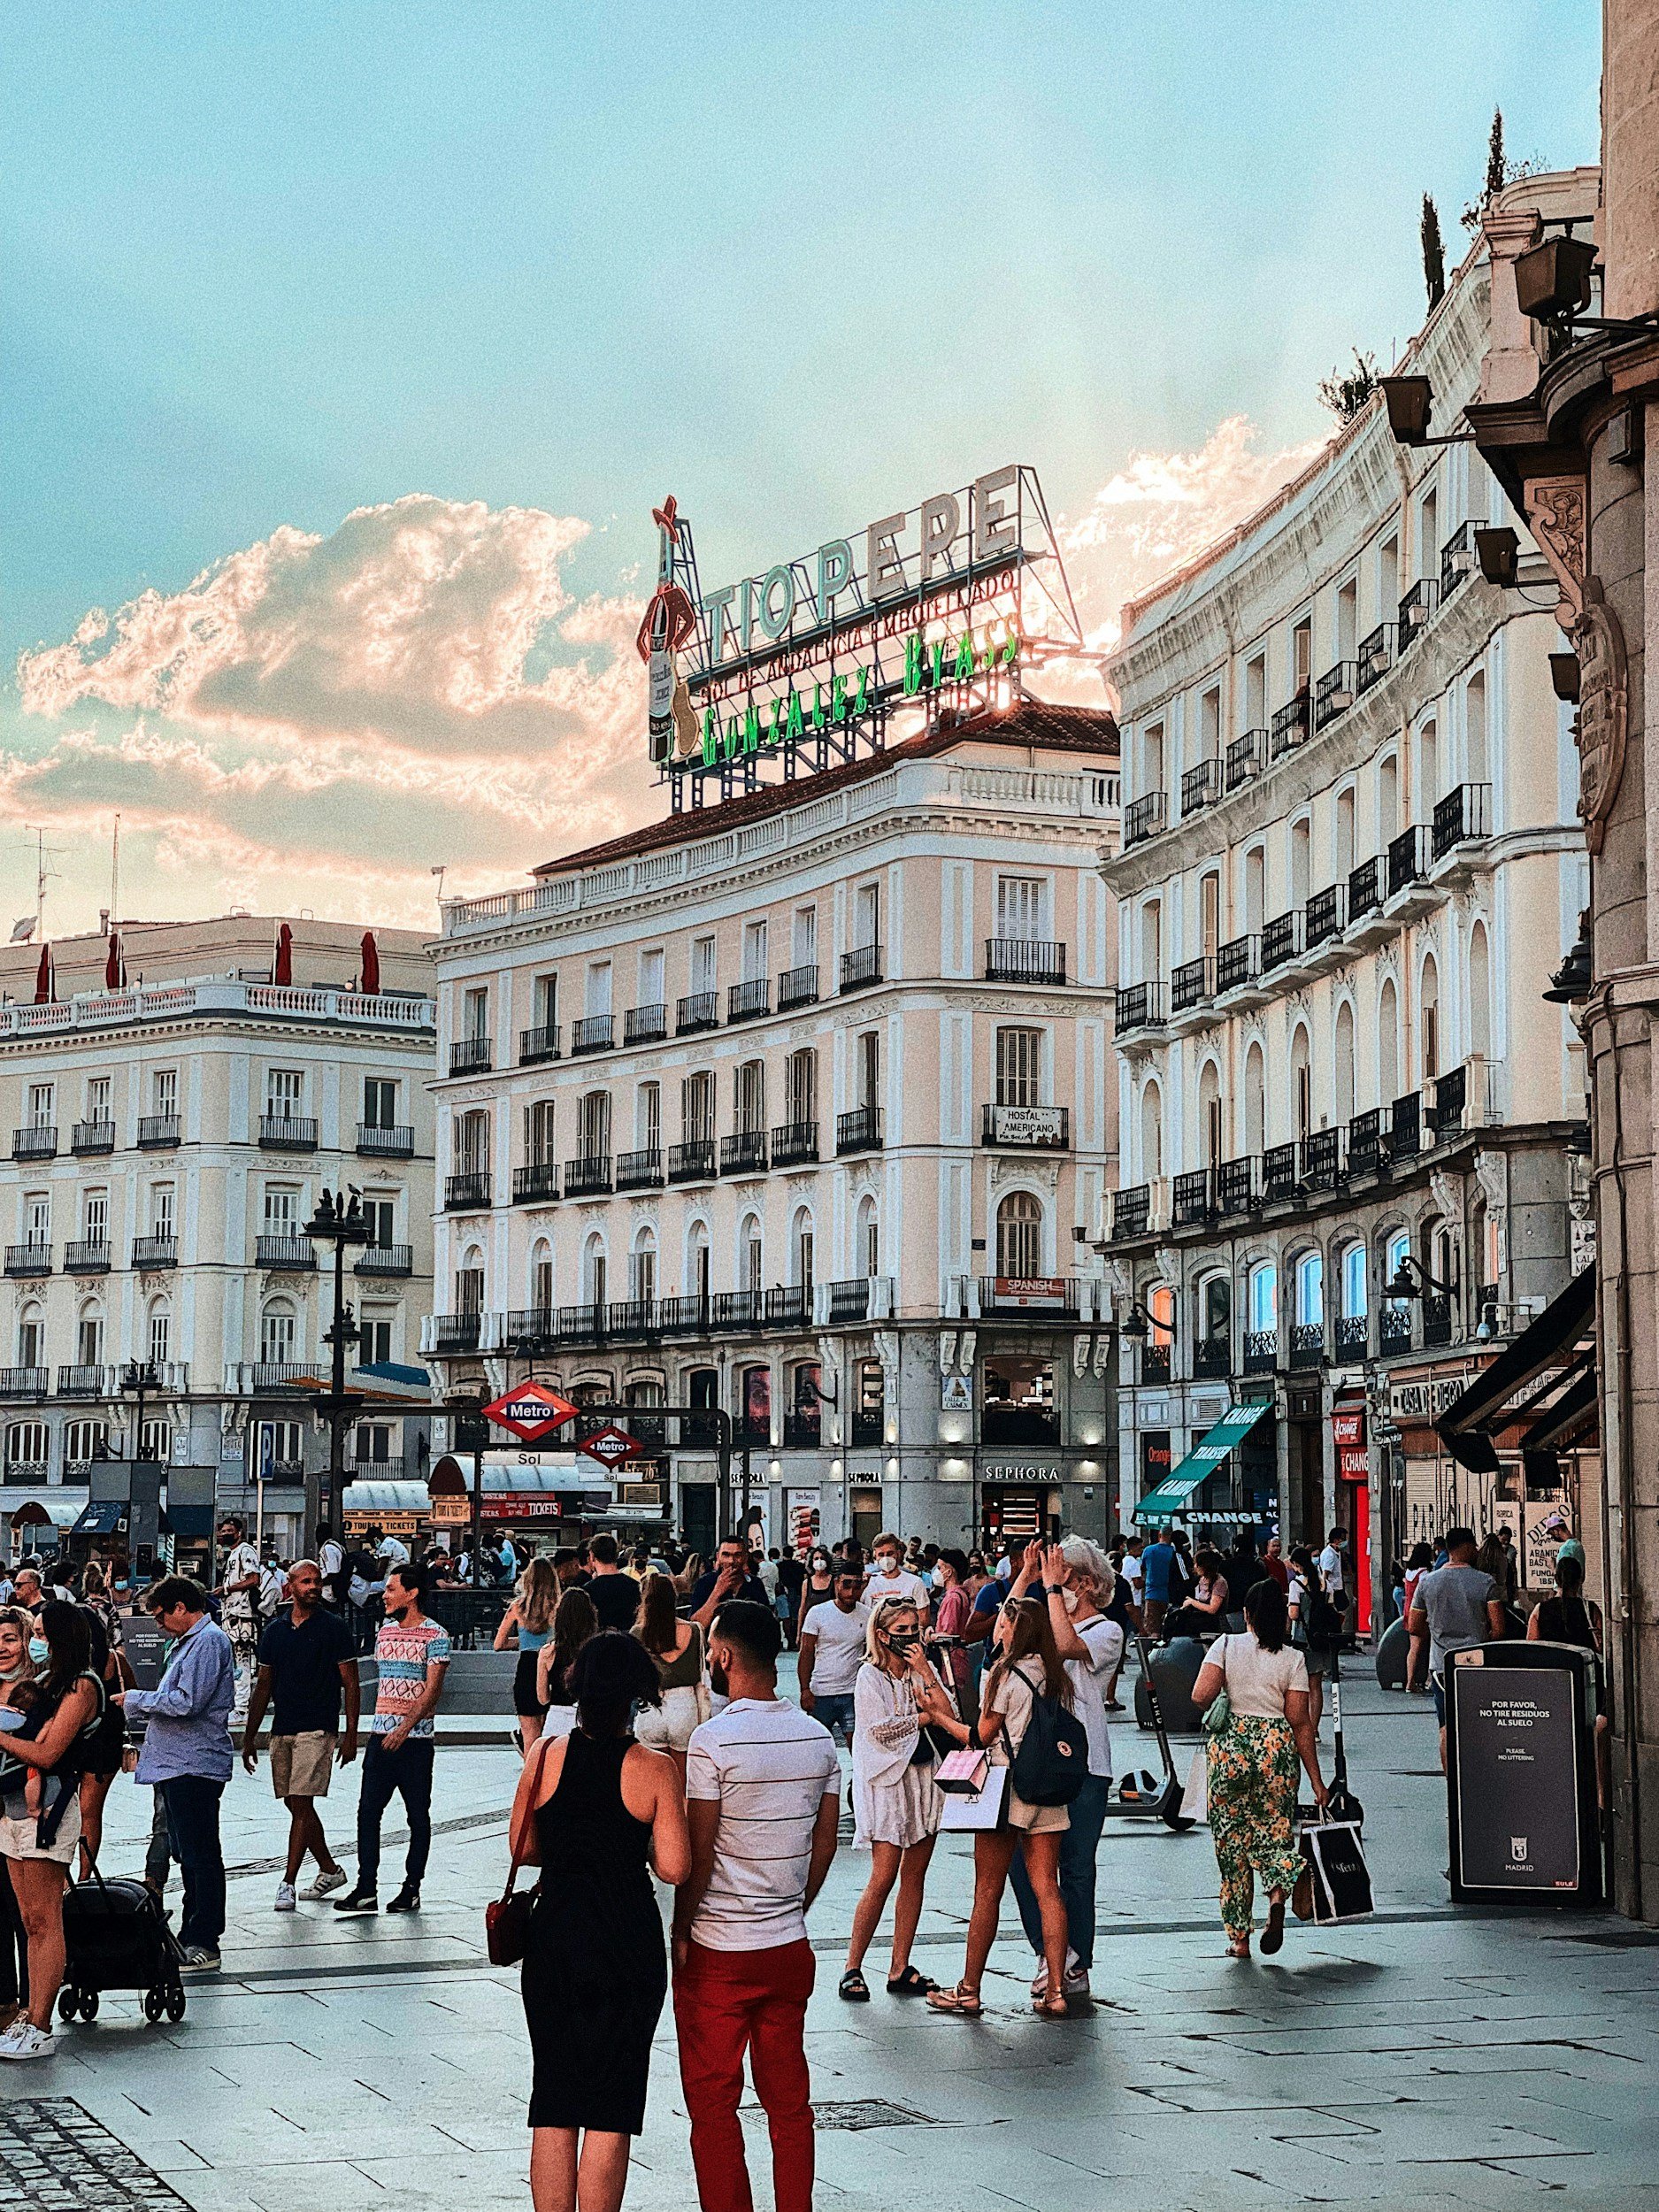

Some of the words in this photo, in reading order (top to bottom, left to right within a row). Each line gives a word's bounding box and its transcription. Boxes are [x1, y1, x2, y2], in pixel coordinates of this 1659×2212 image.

[703, 565, 795, 662] TIO
[818, 465, 1018, 621] PEPE
[739, 667, 761, 692] DE
[703, 666, 869, 767] GONZALEZ
[903, 612, 1017, 696] BYASS
[1009, 1111, 1040, 1121] HOSTAL
[1004, 1123, 1054, 1133] AMERICANO
[1008, 1279, 1053, 1291] SPANISH
[511, 1405, 551, 1417] Metro
[1222, 1406, 1267, 1425] CHANGE
[596, 1442, 625, 1451] Metro
[518, 1454, 541, 1465] Sol
[1346, 1452, 1369, 1471] CHANG
[731, 1472, 765, 1484] SEPORA
[848, 1472, 881, 1483] SEPHORA
[986, 1466, 1059, 1479] SEPHORA
[528, 1502, 558, 1516] TICKETS
[1186, 1512, 1263, 1524] CHANGE
[1509, 1701, 1538, 1709] FAVOR,
